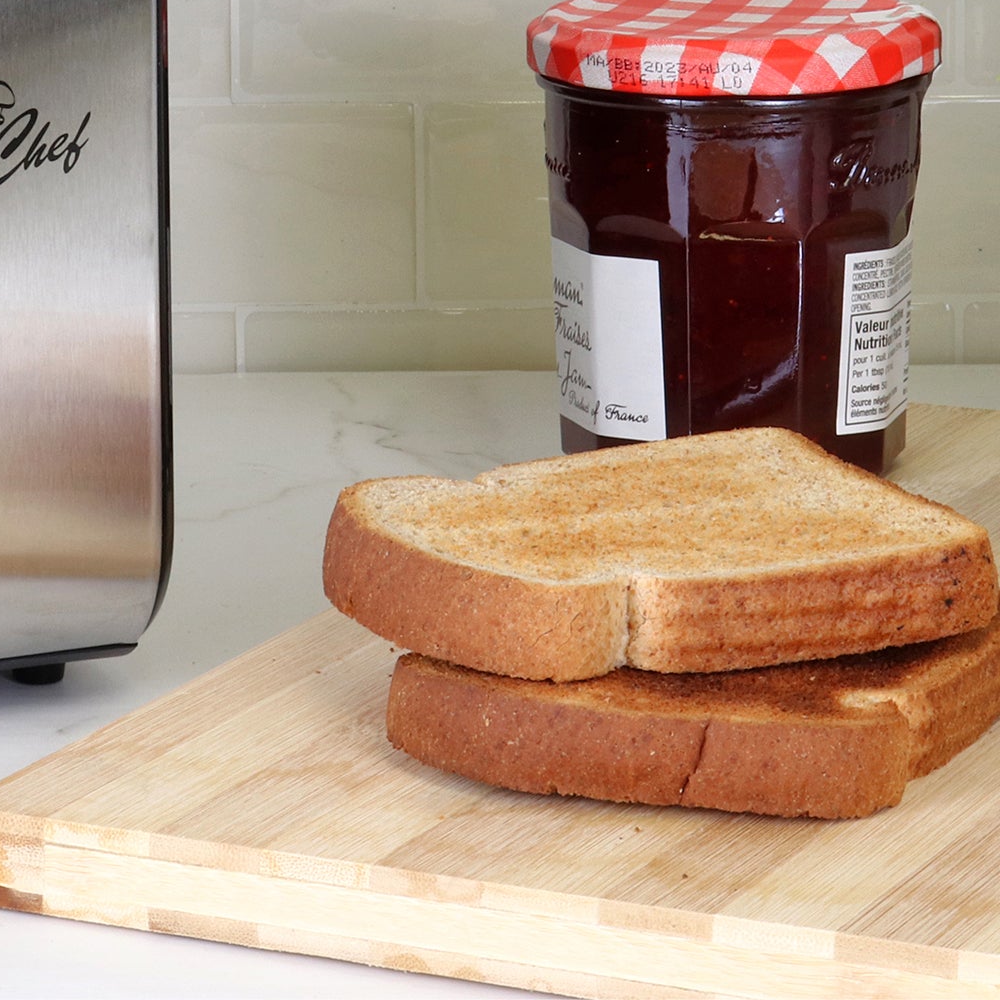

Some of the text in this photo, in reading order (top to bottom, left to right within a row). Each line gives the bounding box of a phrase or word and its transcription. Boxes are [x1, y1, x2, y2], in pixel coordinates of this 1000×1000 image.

[855, 319, 889, 334] Valeur
[870, 355, 874, 364] 1
[852, 369, 863, 378] Per
[865, 369, 869, 377] 1
[852, 383, 880, 393] Calories
[851, 399, 872, 408] Source
[604, 403, 649, 424] France
